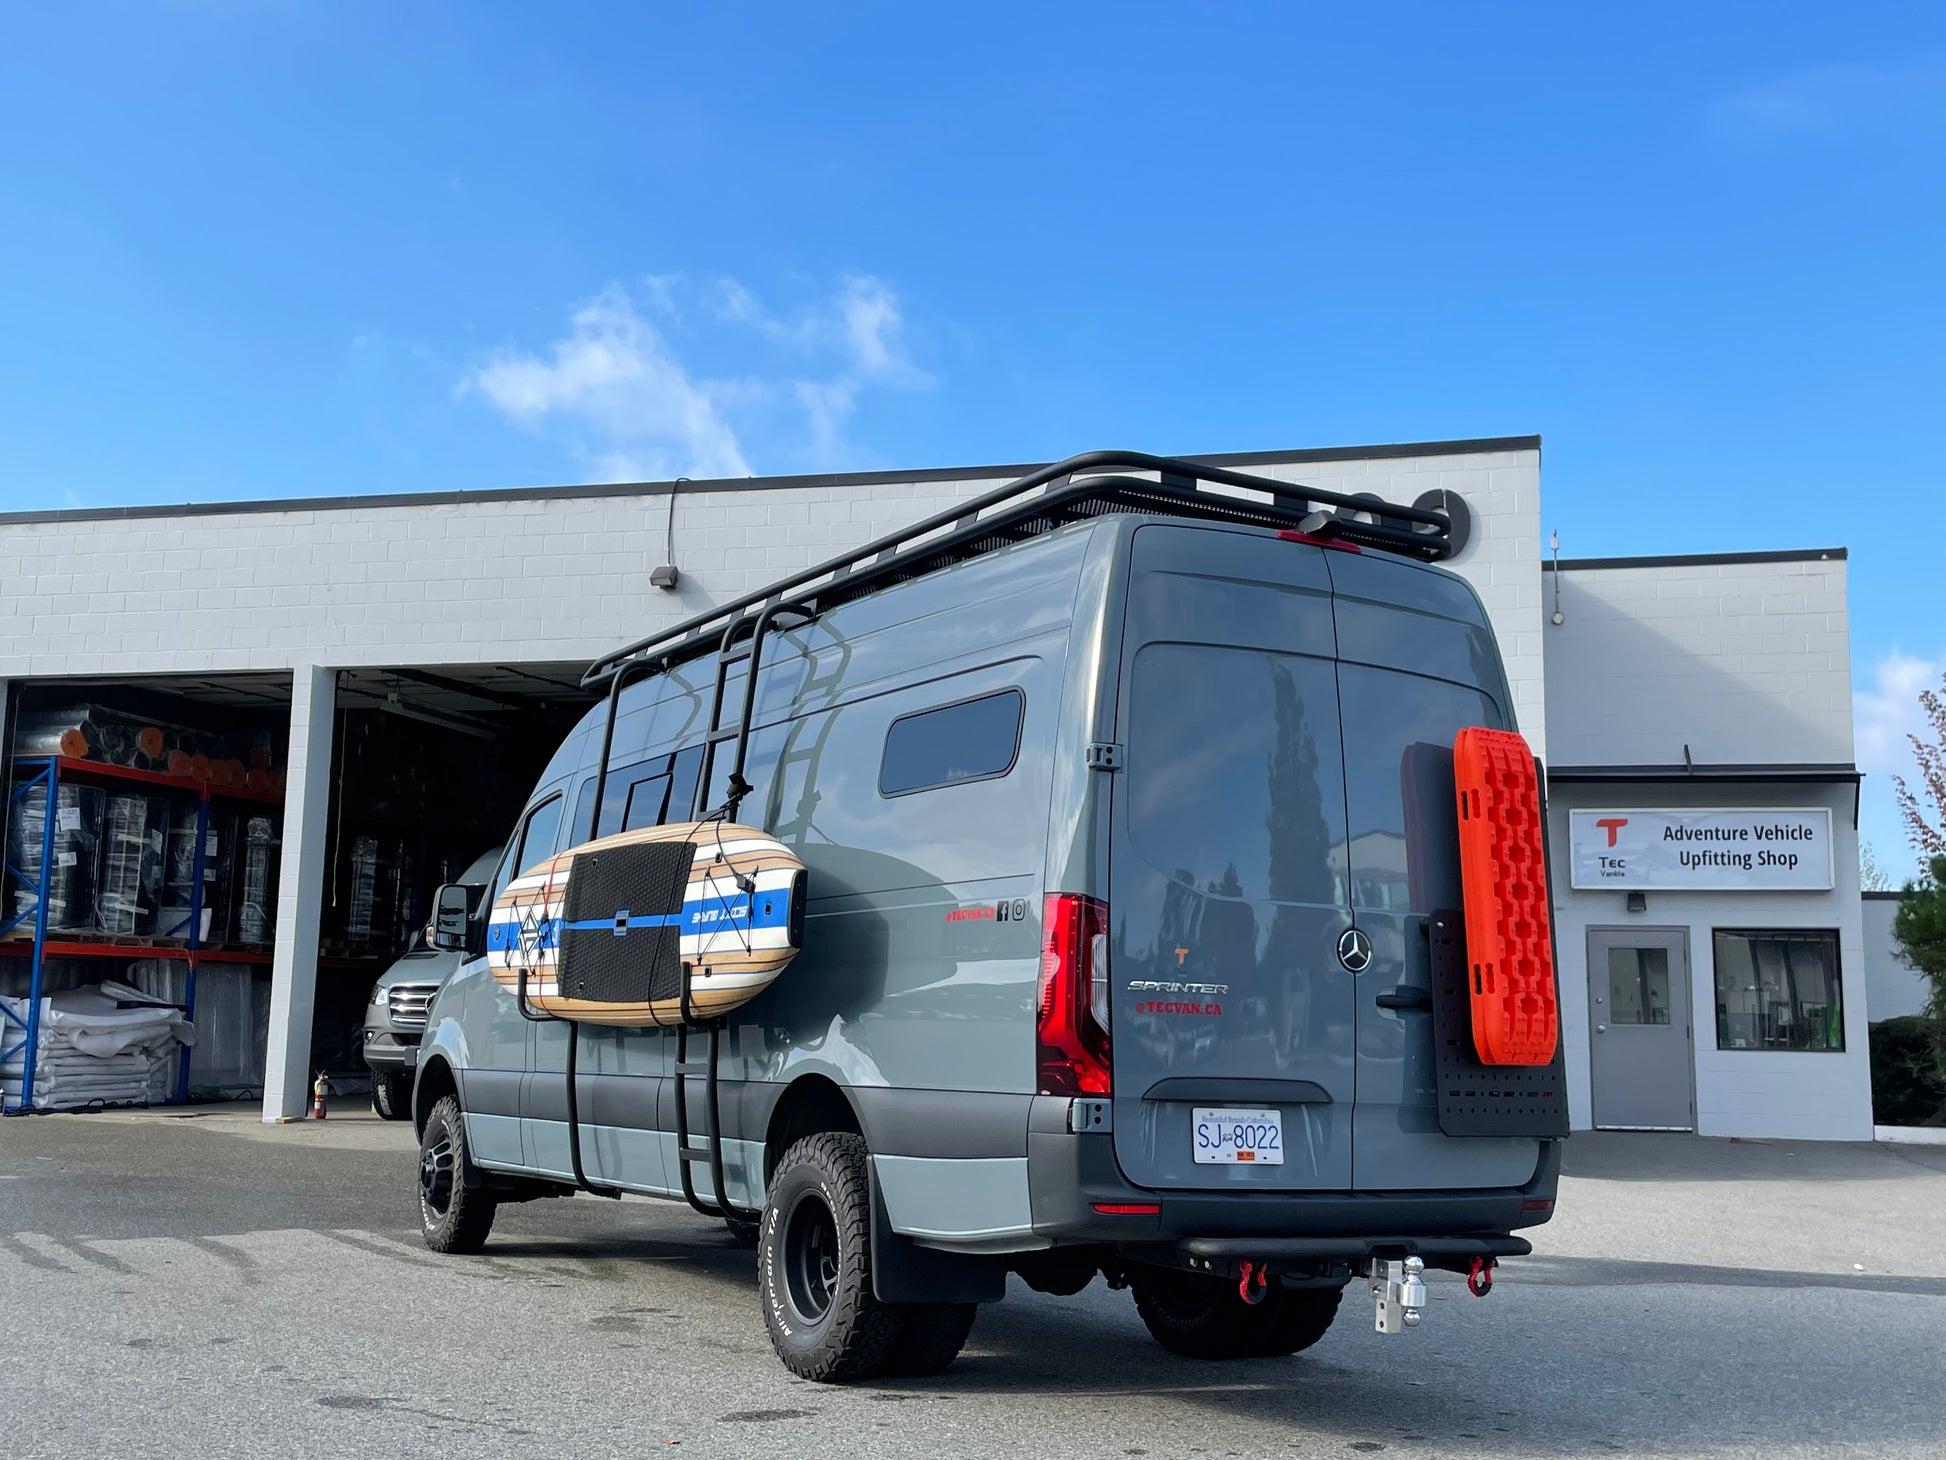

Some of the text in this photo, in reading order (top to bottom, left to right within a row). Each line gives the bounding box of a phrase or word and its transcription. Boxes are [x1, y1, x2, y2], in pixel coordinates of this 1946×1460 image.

[1663, 824, 1813, 841] Adventure Vehicle
[1679, 850, 1799, 870] Upfitting Shop
[1127, 980, 1230, 995] SPRINTER
[1233, 1125, 1279, 1149] 8022
[766, 1245, 793, 1337] All-Terrain
